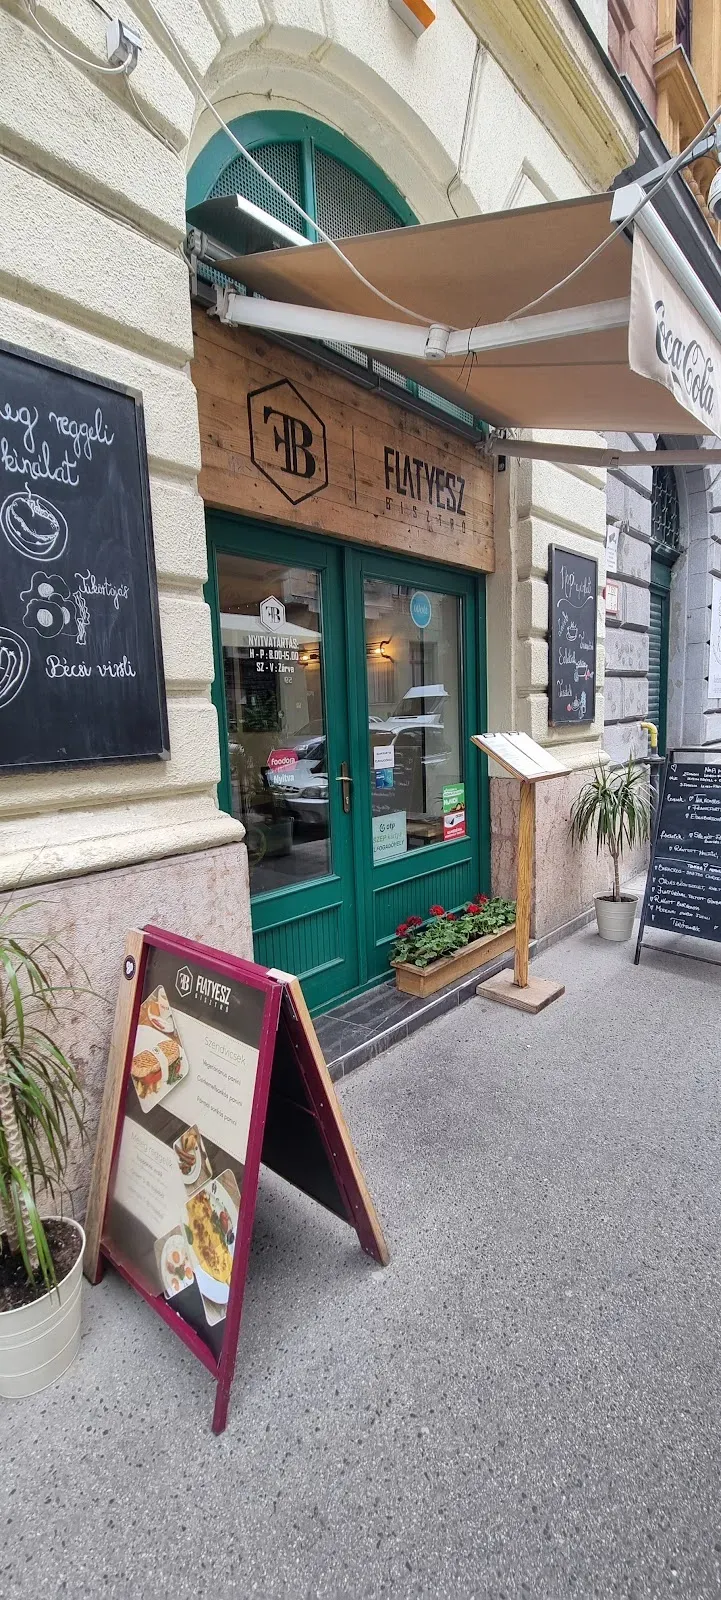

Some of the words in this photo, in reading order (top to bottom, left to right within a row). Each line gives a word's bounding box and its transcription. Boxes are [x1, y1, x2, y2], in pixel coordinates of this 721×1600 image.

[48, 407, 115, 461] reggeli
[1, 437, 79, 486] kínálat
[383, 445, 466, 517] FLATYESZ
[248, 634, 300, 650] NYITVATARTÁS:
[249, 648, 255, 659] H
[45, 655, 92, 678] Bécsi
[96, 655, 136, 677] virsli
[256, 662, 265, 672] SZ
[269, 662, 274, 673] V
[278, 663, 295, 673] Zárva
[273, 773, 295, 785] Nyitva
[195, 974, 232, 1006] FLATYESZ
[204, 1036, 247, 1066] Szendvicsek
